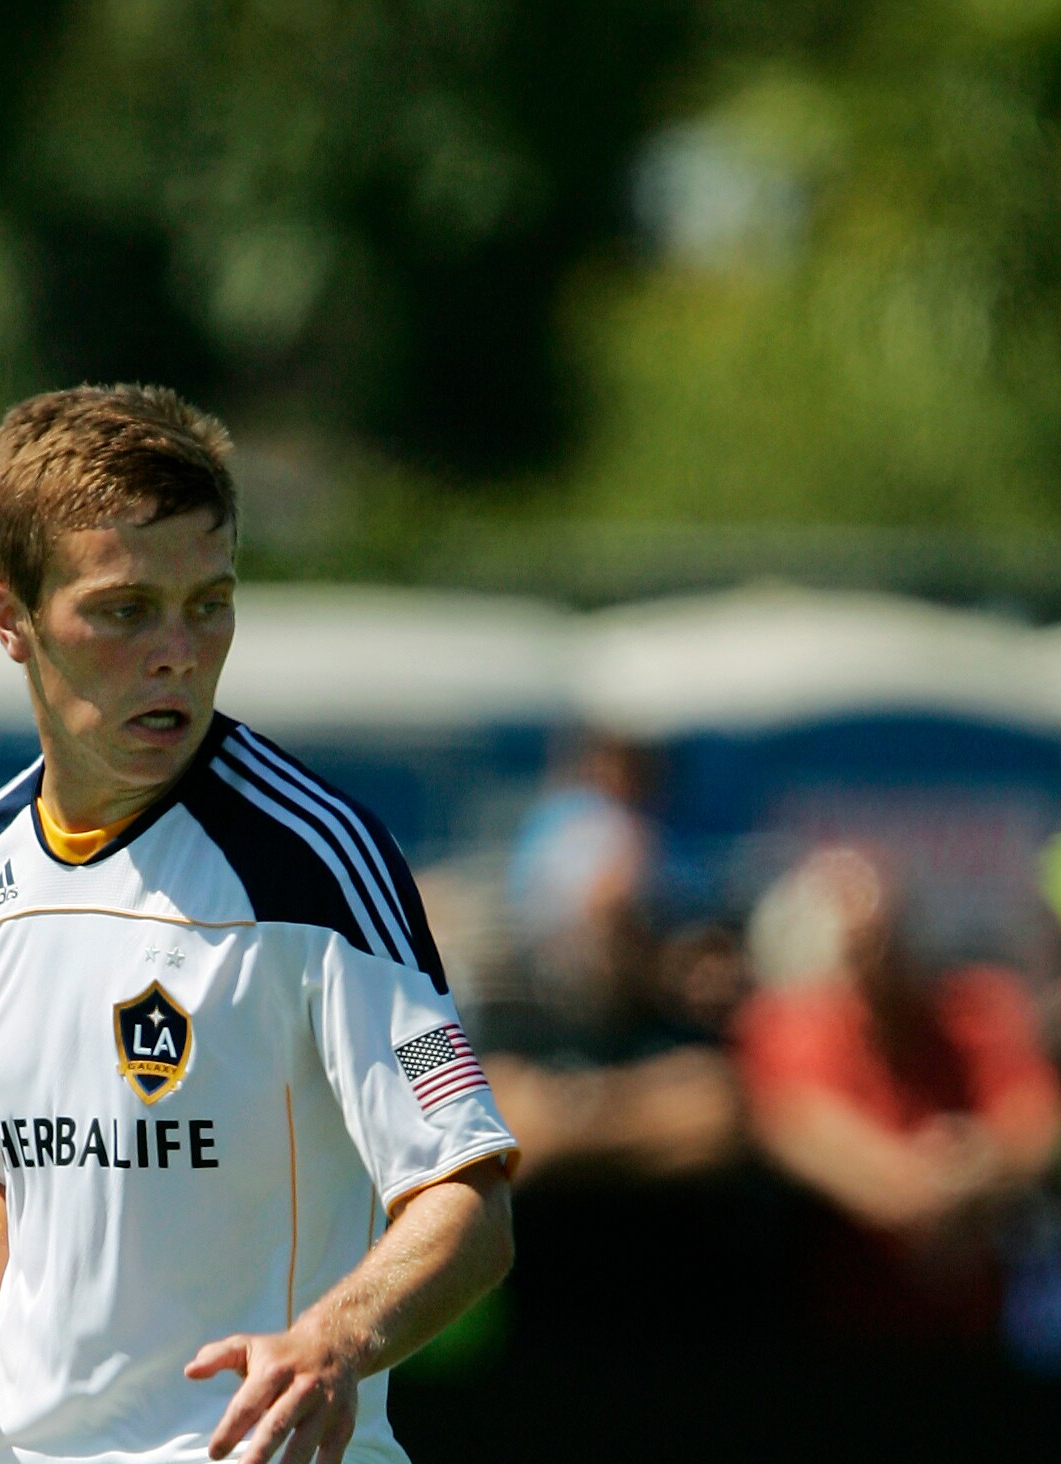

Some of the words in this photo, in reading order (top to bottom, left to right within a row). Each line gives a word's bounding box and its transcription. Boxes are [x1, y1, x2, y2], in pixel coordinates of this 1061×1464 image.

[133, 1023, 178, 1058] LA
[127, 1062, 178, 1075] GALAXY
[0, 1116, 220, 1169] HERBALIFE
